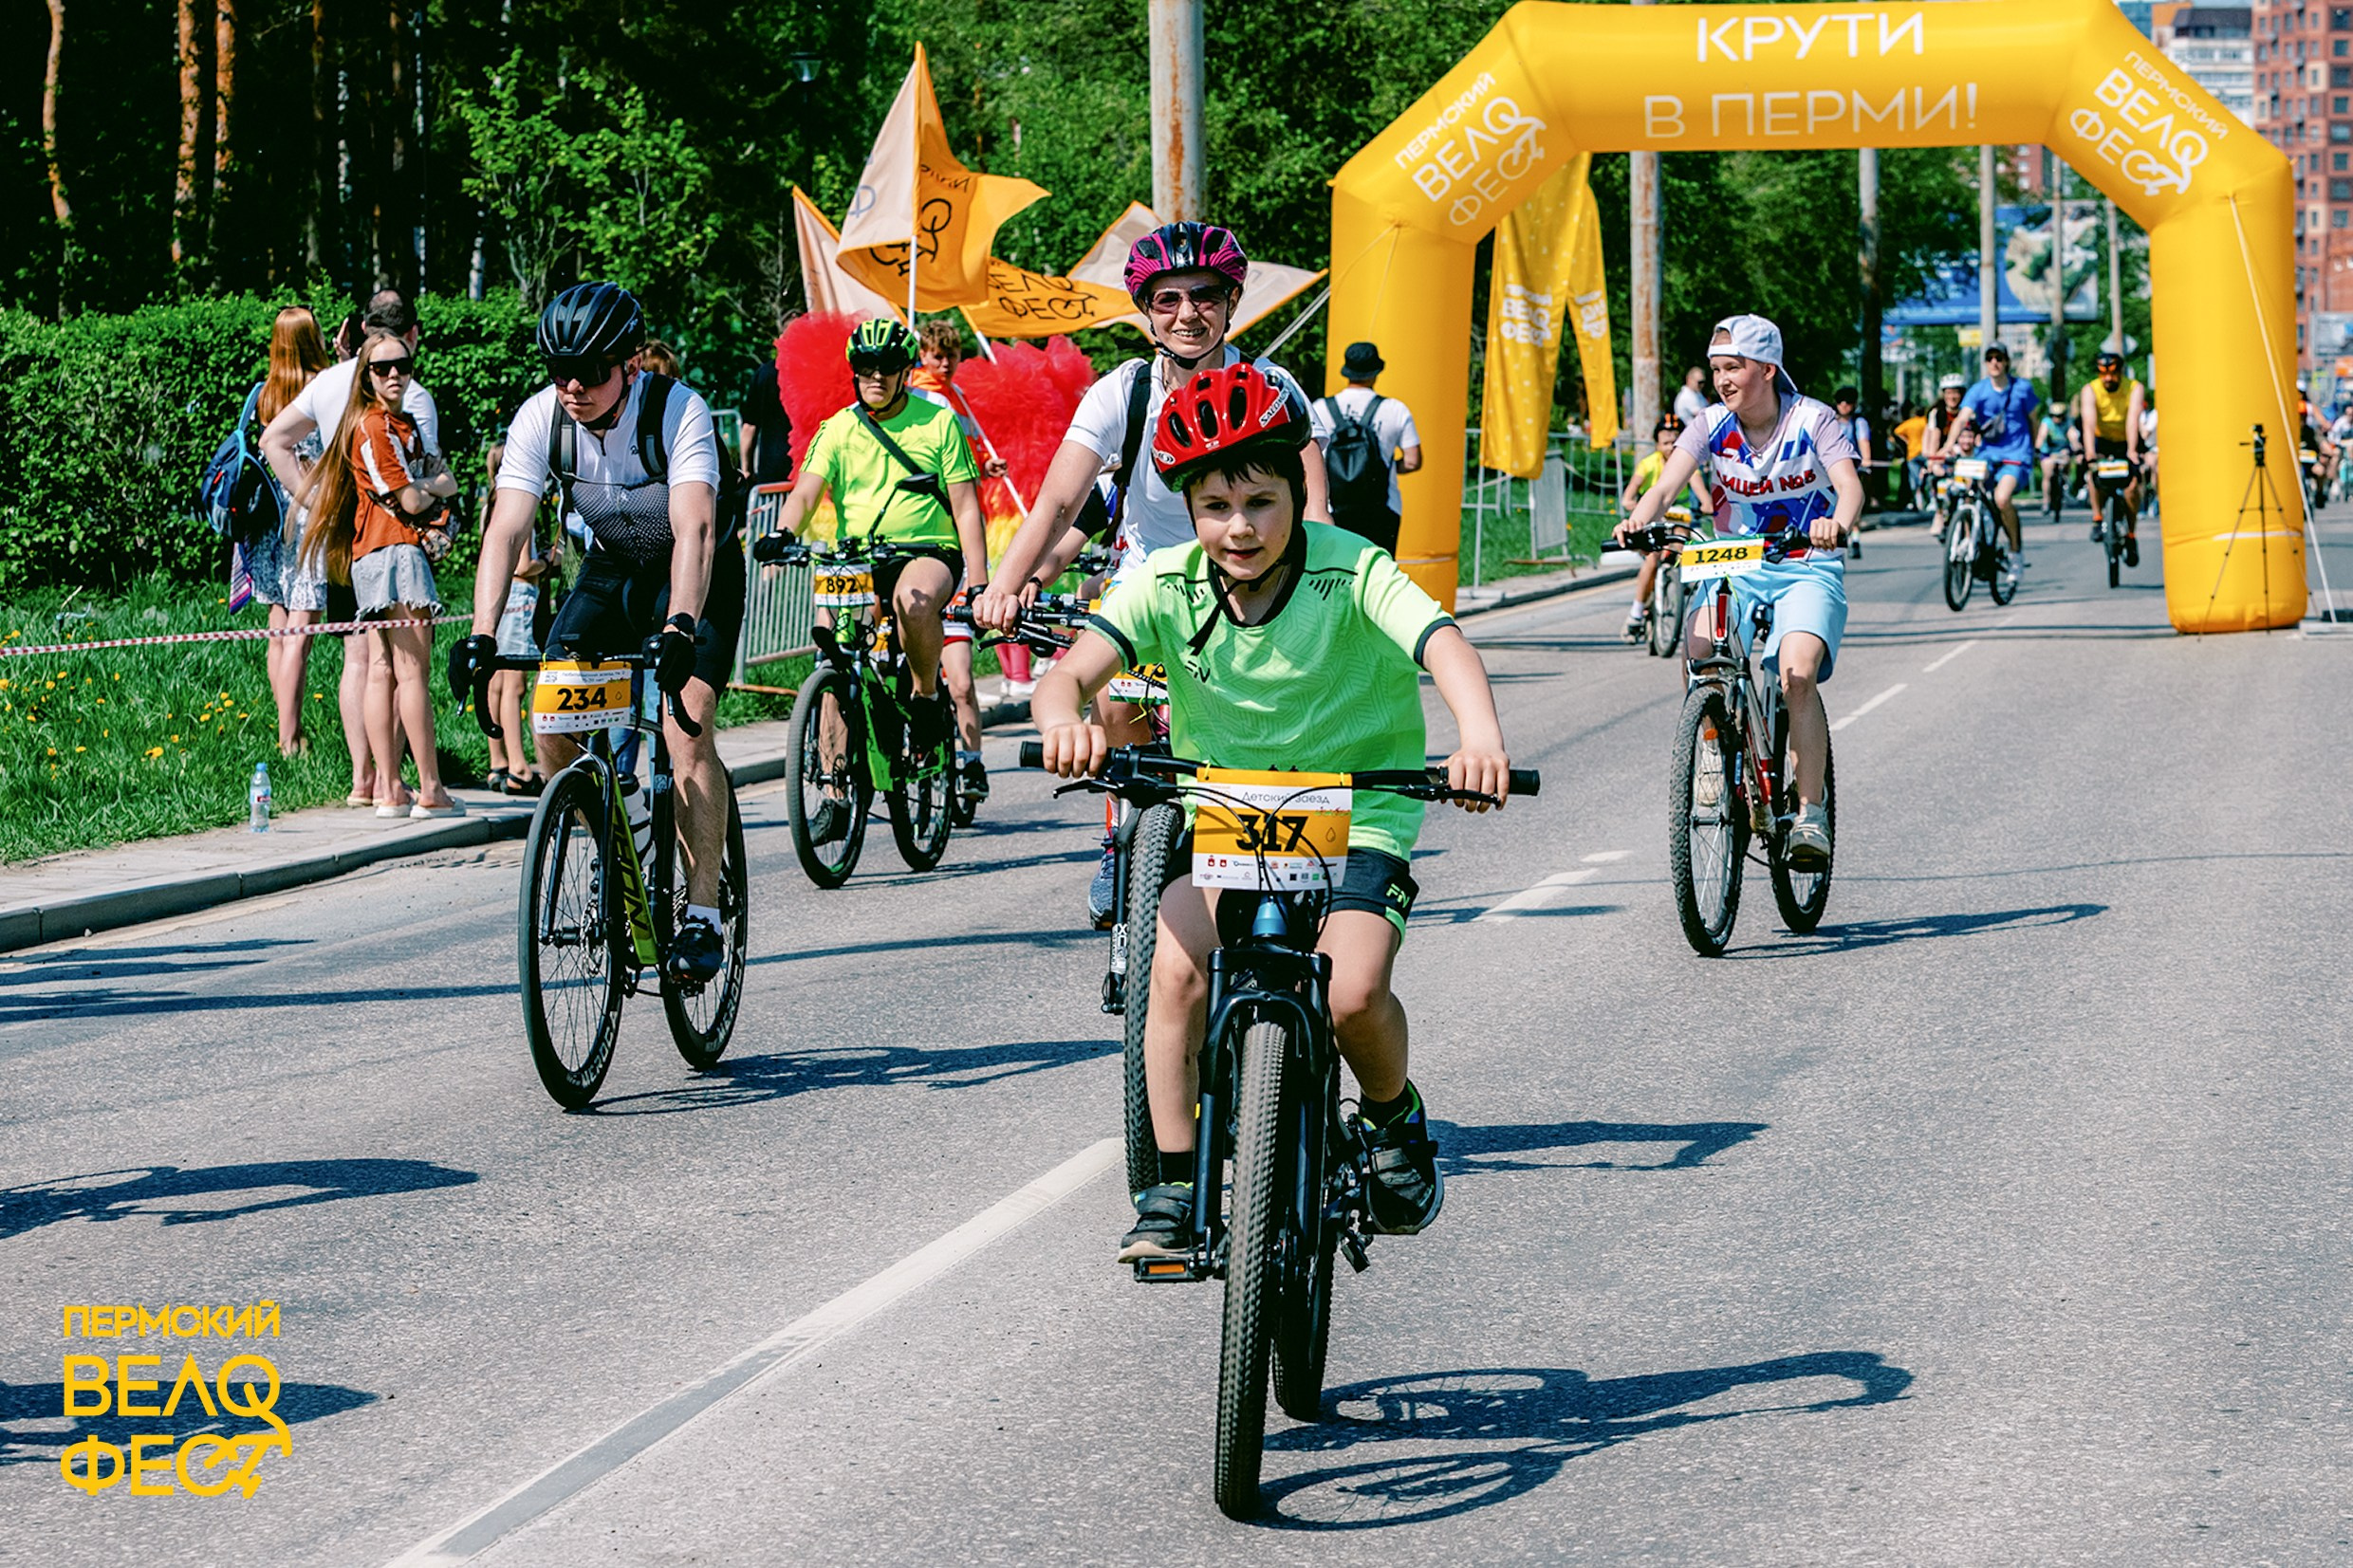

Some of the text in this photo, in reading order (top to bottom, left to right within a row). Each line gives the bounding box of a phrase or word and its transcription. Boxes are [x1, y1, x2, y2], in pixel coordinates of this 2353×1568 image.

[1696, 11, 1924, 63] КРУТИ
[1394, 72, 1496, 170] ПЕРМСКИЙ
[1644, 82, 1977, 138] В ПЕРМИ!
[2123, 50, 2230, 140] ПЕРМСКИЙ
[1411, 96, 1547, 202] ВЕЛО
[2093, 67, 2209, 194] ВЕЛО
[1695, 546, 1748, 564] 1248
[826, 577, 858, 594] 892
[557, 687, 607, 711] 234
[1242, 790, 1291, 804] Детский
[1235, 813, 1309, 853] 317
[581, 1010, 619, 1089] MEROCA
